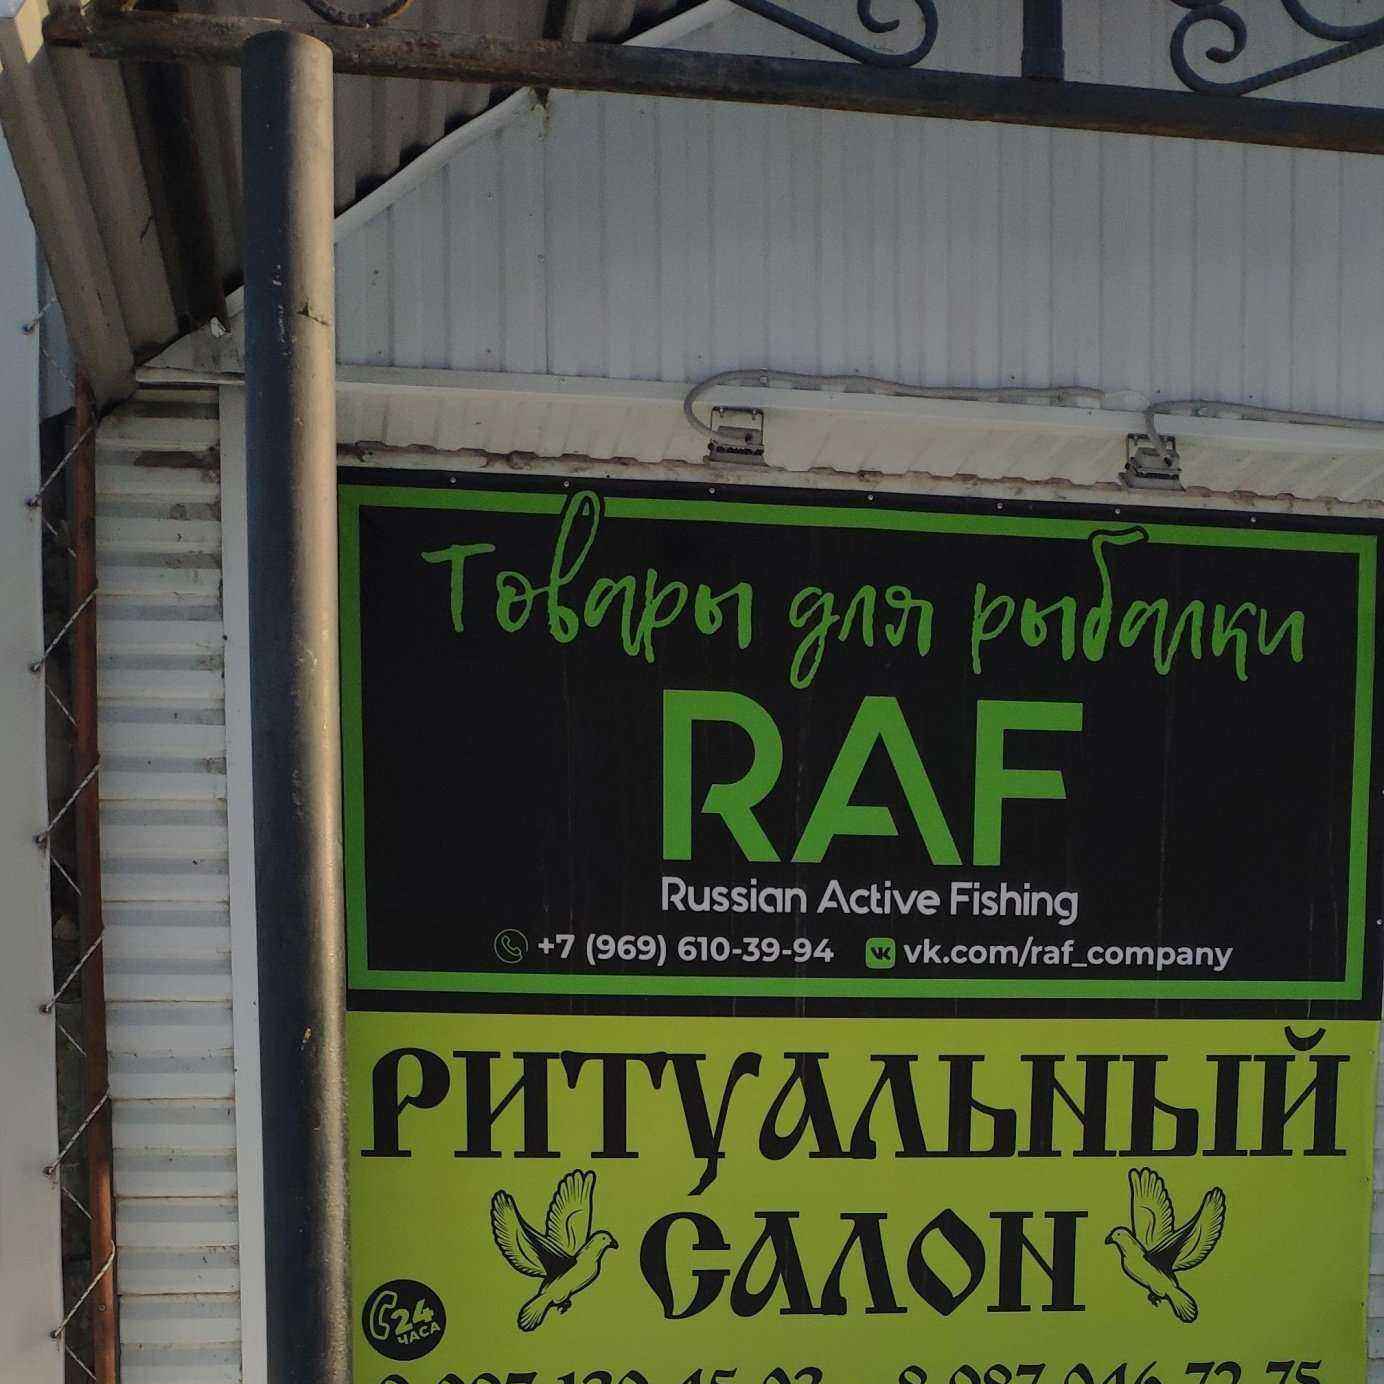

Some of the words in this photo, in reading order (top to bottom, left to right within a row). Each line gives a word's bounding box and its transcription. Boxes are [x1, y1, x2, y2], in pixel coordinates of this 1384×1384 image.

[421, 490, 753, 663] Товары
[789, 584, 934, 689] для
[970, 527, 1304, 681] рыбалки
[662, 689, 1084, 866] RAF
[661, 875, 807, 914] Russian
[816, 879, 941, 916] Active
[950, 880, 1079, 925] Fishing
[537, 933, 575, 960] +7
[586, 934, 667, 967] (969)
[677, 935, 834, 963] 610-39-94
[903, 936, 1233, 971] vk.com/raf_company
[361, 1026, 1351, 1196] РИТУАЛЬНЫЙ
[639, 1208, 1089, 1320] САЛОН
[391, 1299, 434, 1335] 24
[397, 1321, 441, 1345] ЧАСА
